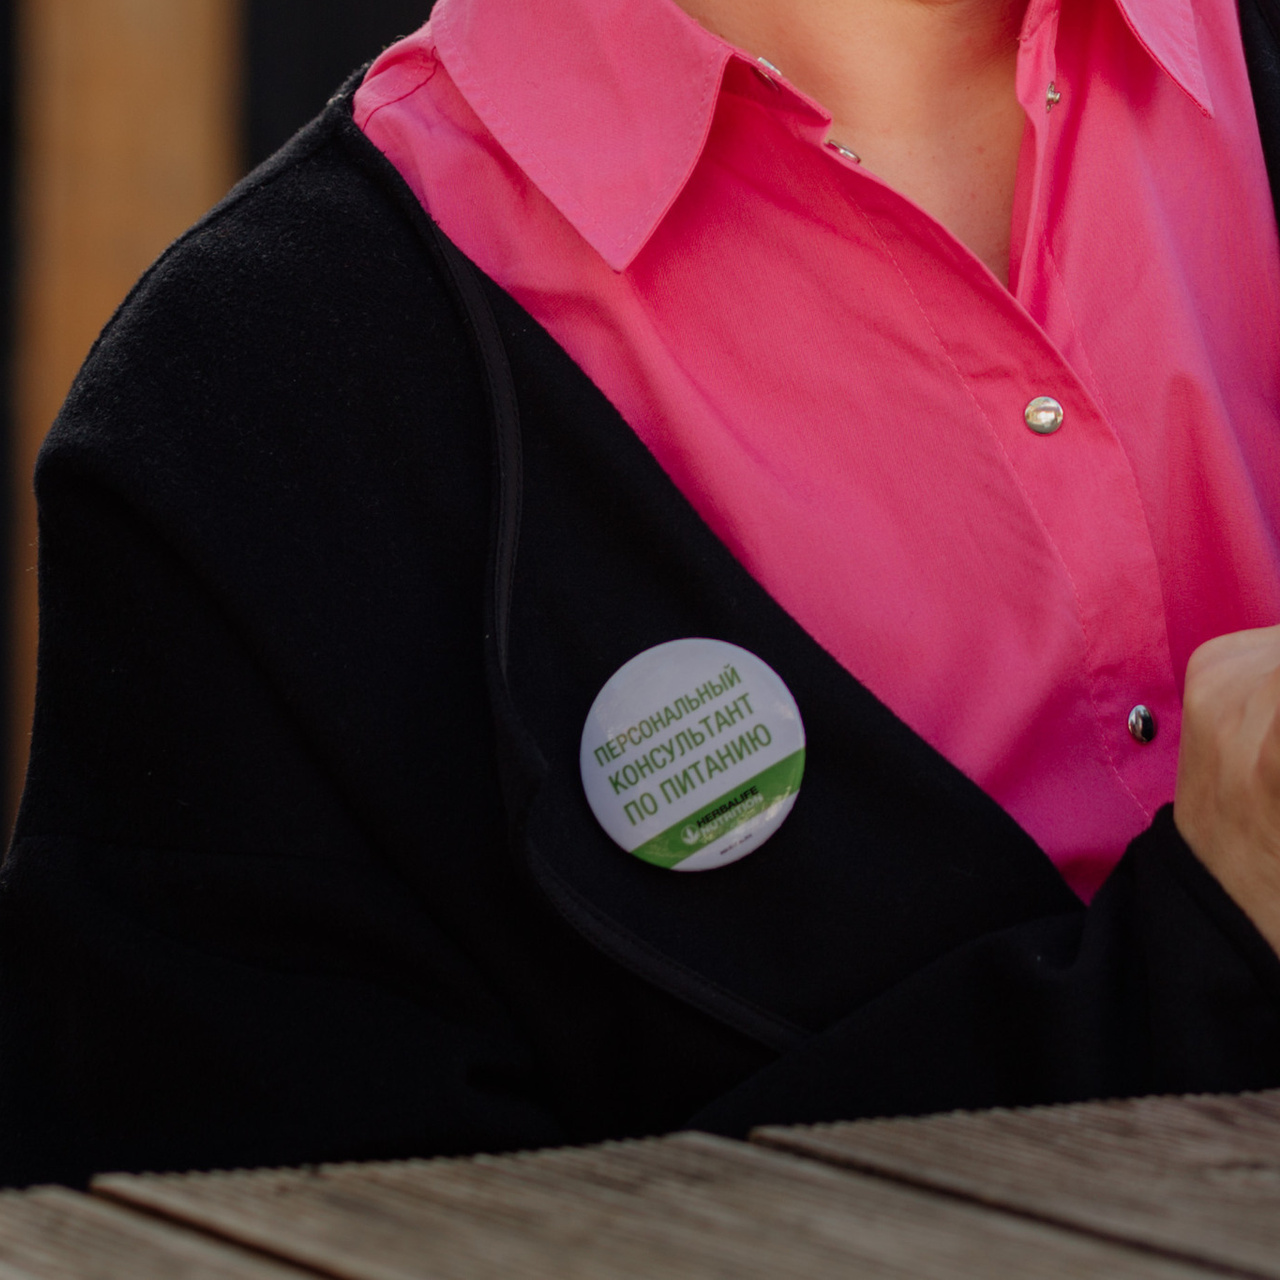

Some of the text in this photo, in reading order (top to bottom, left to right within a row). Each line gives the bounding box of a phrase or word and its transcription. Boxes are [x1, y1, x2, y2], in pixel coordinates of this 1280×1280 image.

[593, 664, 742, 766] ПЕРСОНАЛЬНЫЙ
[608, 692, 755, 795] КОНСУЛЬТАНТ
[623, 723, 772, 826] ПО ПИТАНИЮ
[696, 785, 759, 828] HERBALIFE
[700, 793, 763, 836] NUTRITION
